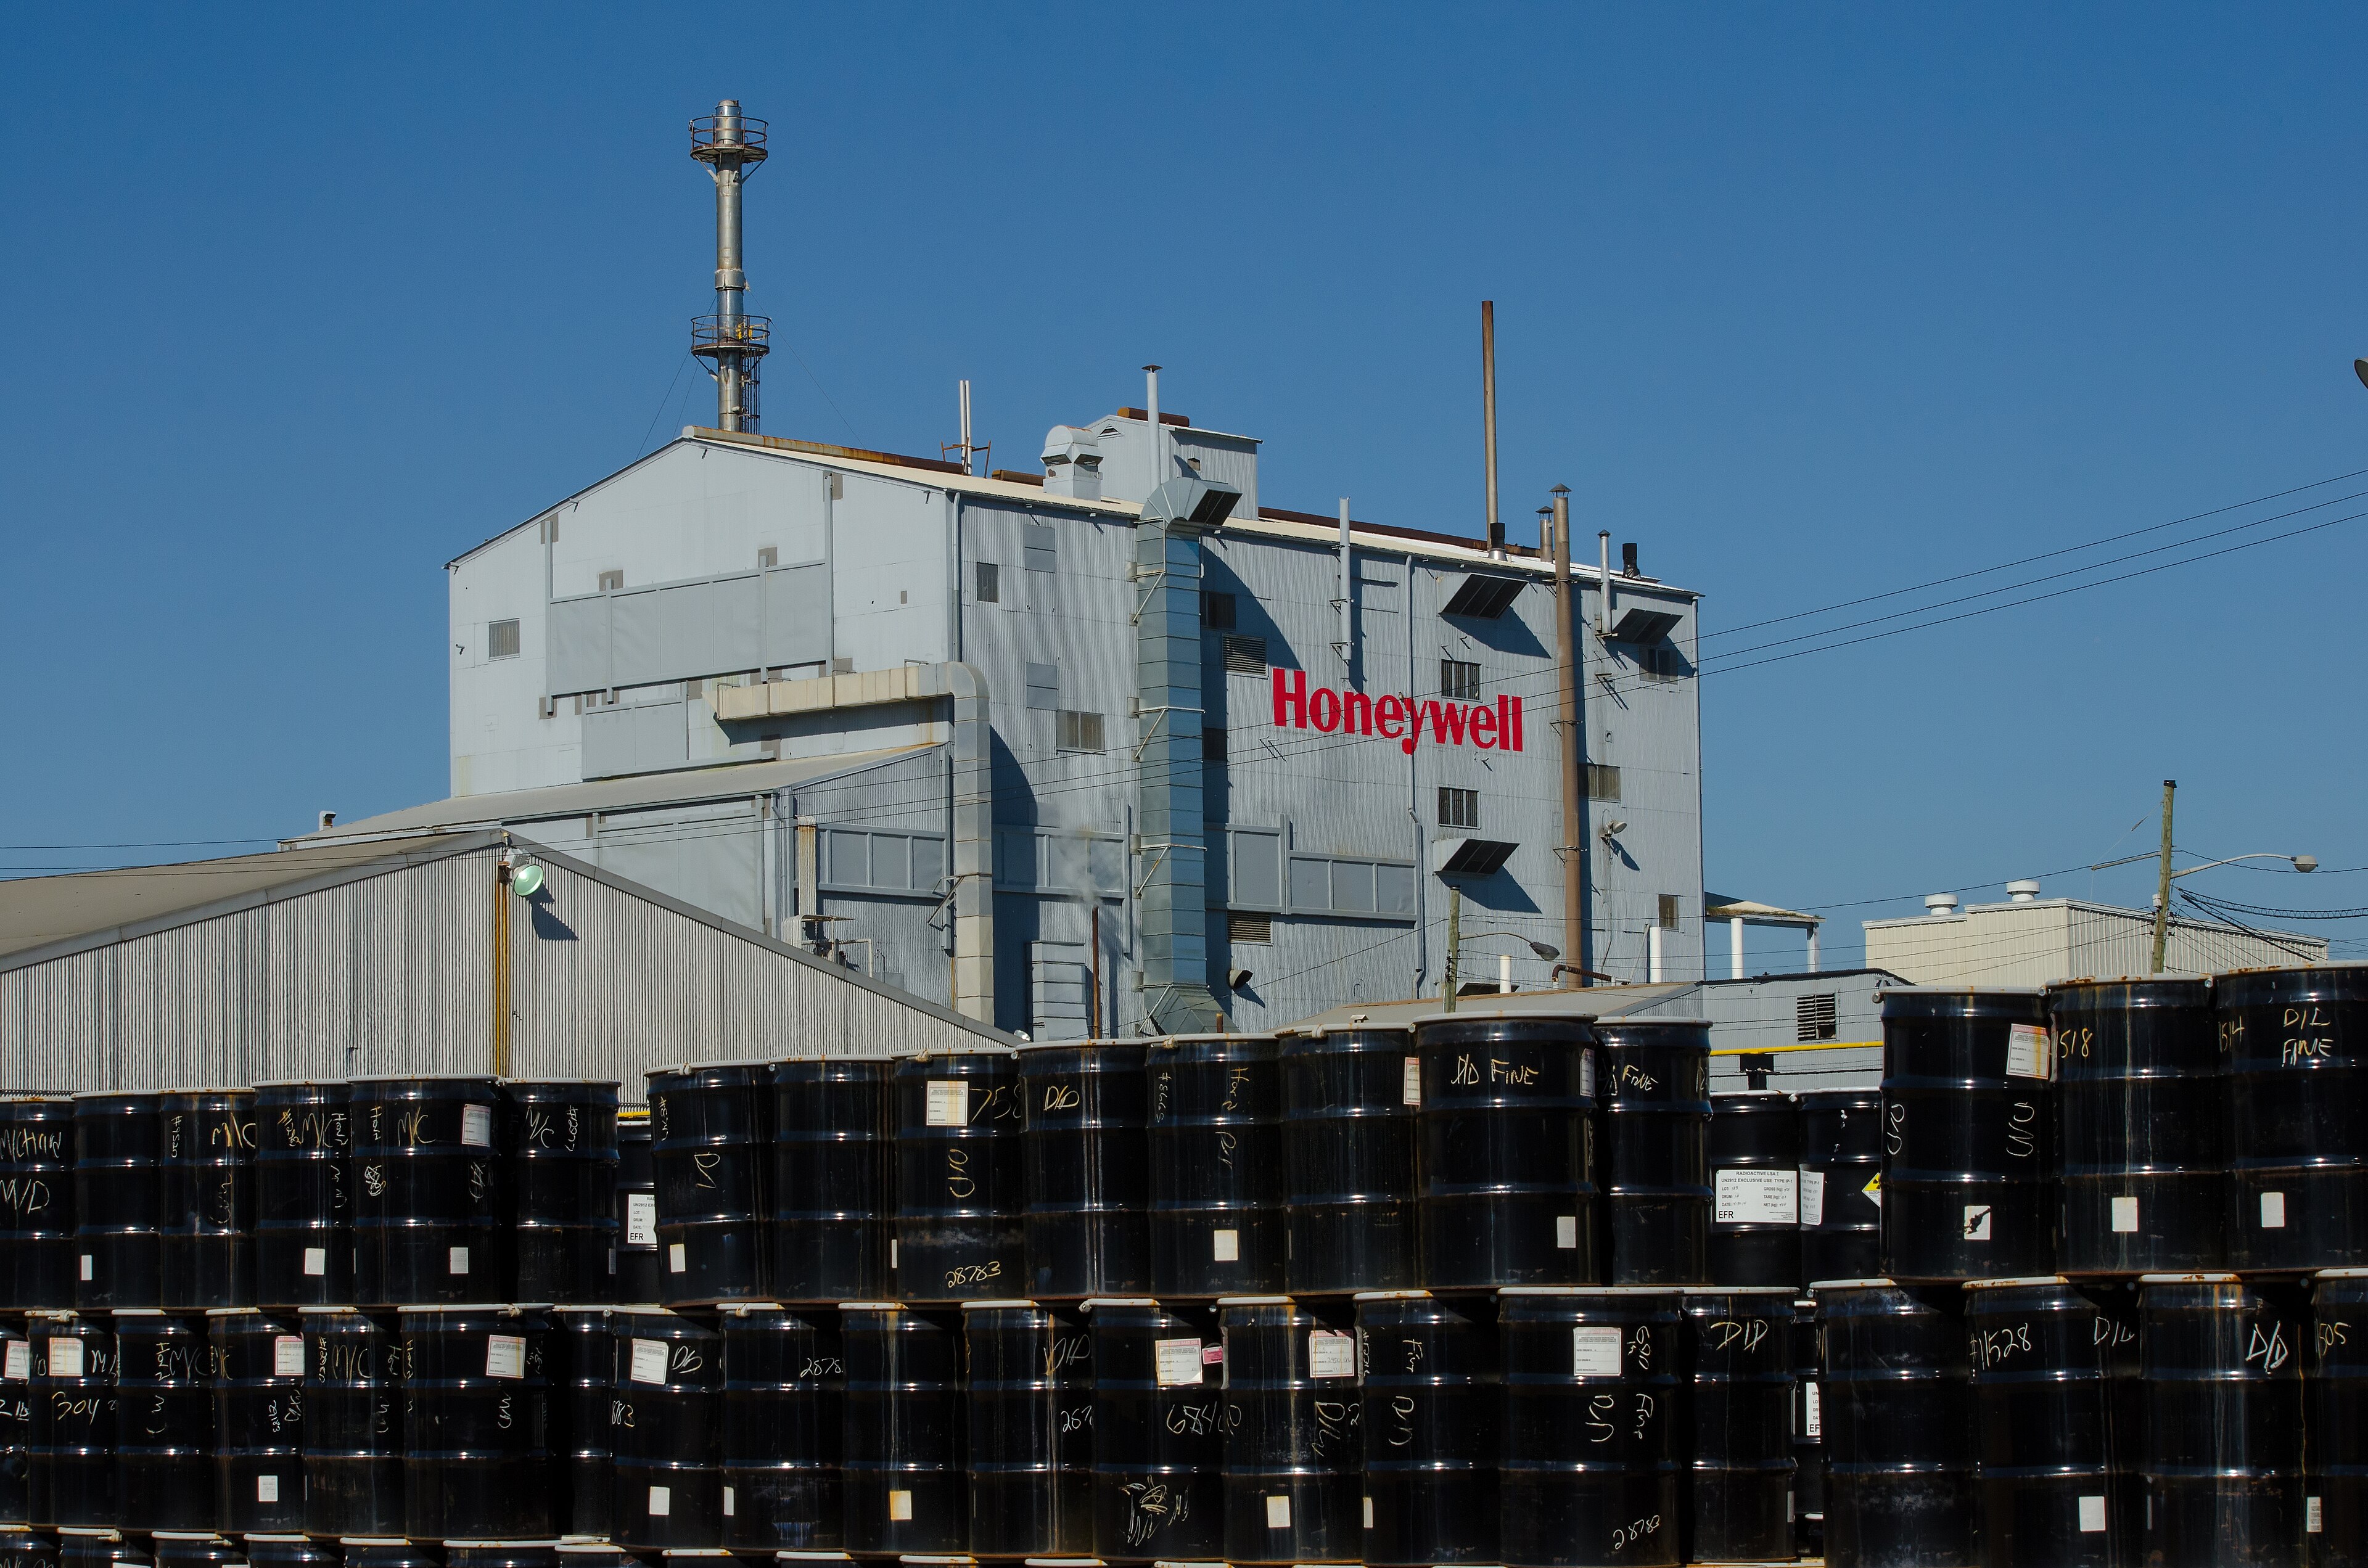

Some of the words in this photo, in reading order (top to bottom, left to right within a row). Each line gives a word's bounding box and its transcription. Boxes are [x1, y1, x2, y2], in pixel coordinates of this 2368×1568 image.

[1272, 668, 1523, 755] Honeywell
[1718, 1210, 1733, 1219] EFR
[630, 1233, 644, 1241] EFR
[945, 1261, 1001, 1288] 28783
[1809, 1424, 1820, 1432] EF
